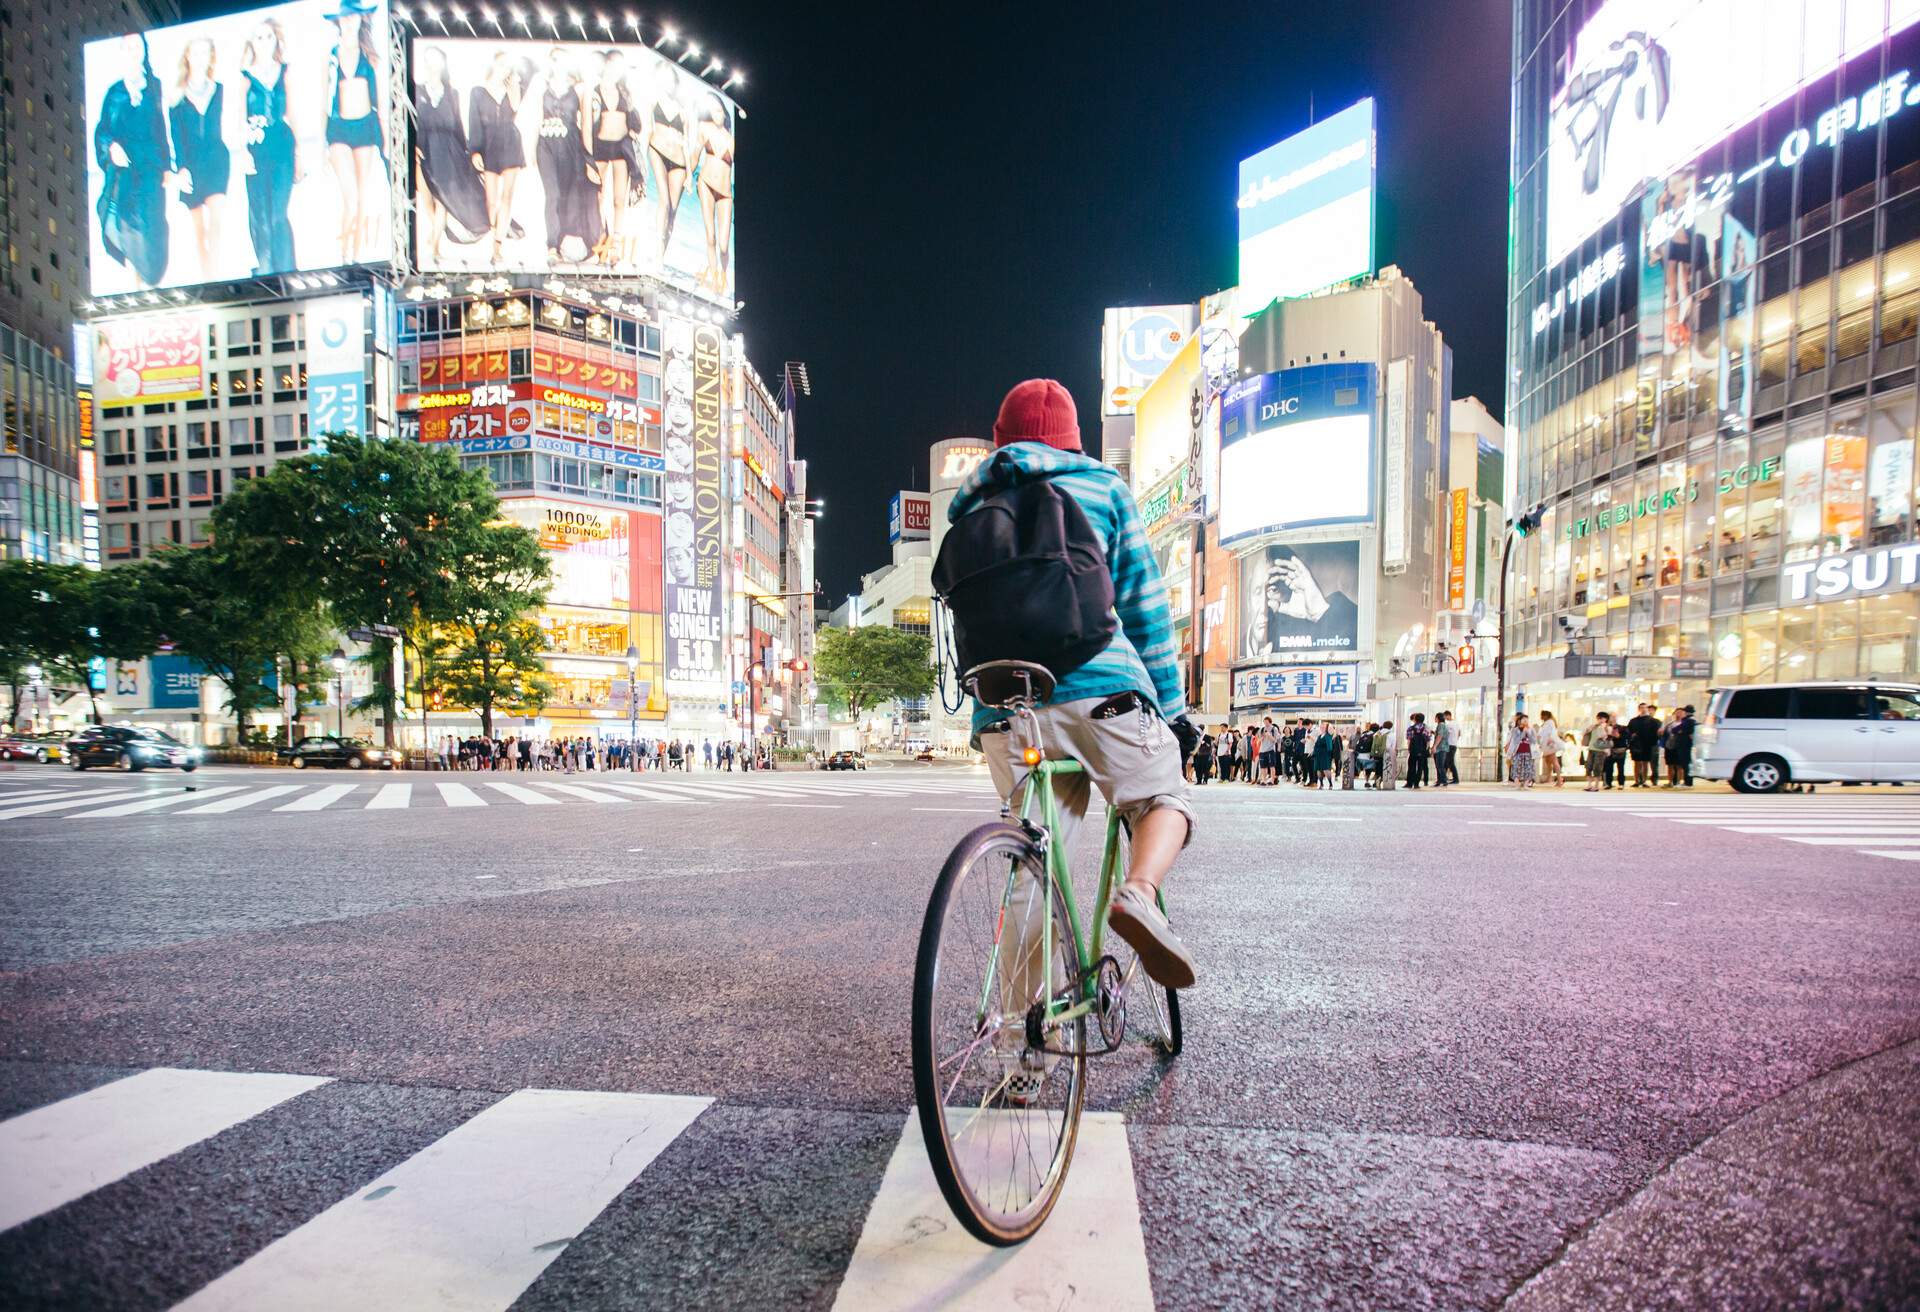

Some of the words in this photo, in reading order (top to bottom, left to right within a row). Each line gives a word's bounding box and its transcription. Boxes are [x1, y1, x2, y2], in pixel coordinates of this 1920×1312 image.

[112, 342, 200, 372] クリニック
[534, 352, 635, 391] コンタクト
[471, 385, 516, 407] ガスト
[1261, 397, 1299, 421] DHC
[449, 413, 502, 439] ガスト
[605, 400, 652, 425] ガスト
[399, 422, 419, 438] 7F
[694, 326, 720, 557] GENERATIONS
[536, 438, 572, 452] AEON
[577, 444, 663, 470] 英会話イーオン
[949, 447, 988, 455] SHIBUYA
[545, 508, 601, 529] 1000%
[908, 502, 929, 515] UNI
[908, 515, 930, 527] QLO
[546, 523, 602, 538] WEDDING!
[697, 557, 705, 587] TRIBE
[704, 558, 713, 588] EXILE
[1783, 544, 1920, 601] TSUT
[1451, 565, 1464, 609] 三千
[676, 587, 713, 615] NEW
[669, 612, 721, 642] SINGLE
[677, 638, 714, 671] 5.13
[1279, 634, 1351, 649] DMM.make
[669, 669, 689, 681] ON
[1236, 670, 1349, 699] 大盛堂書店
